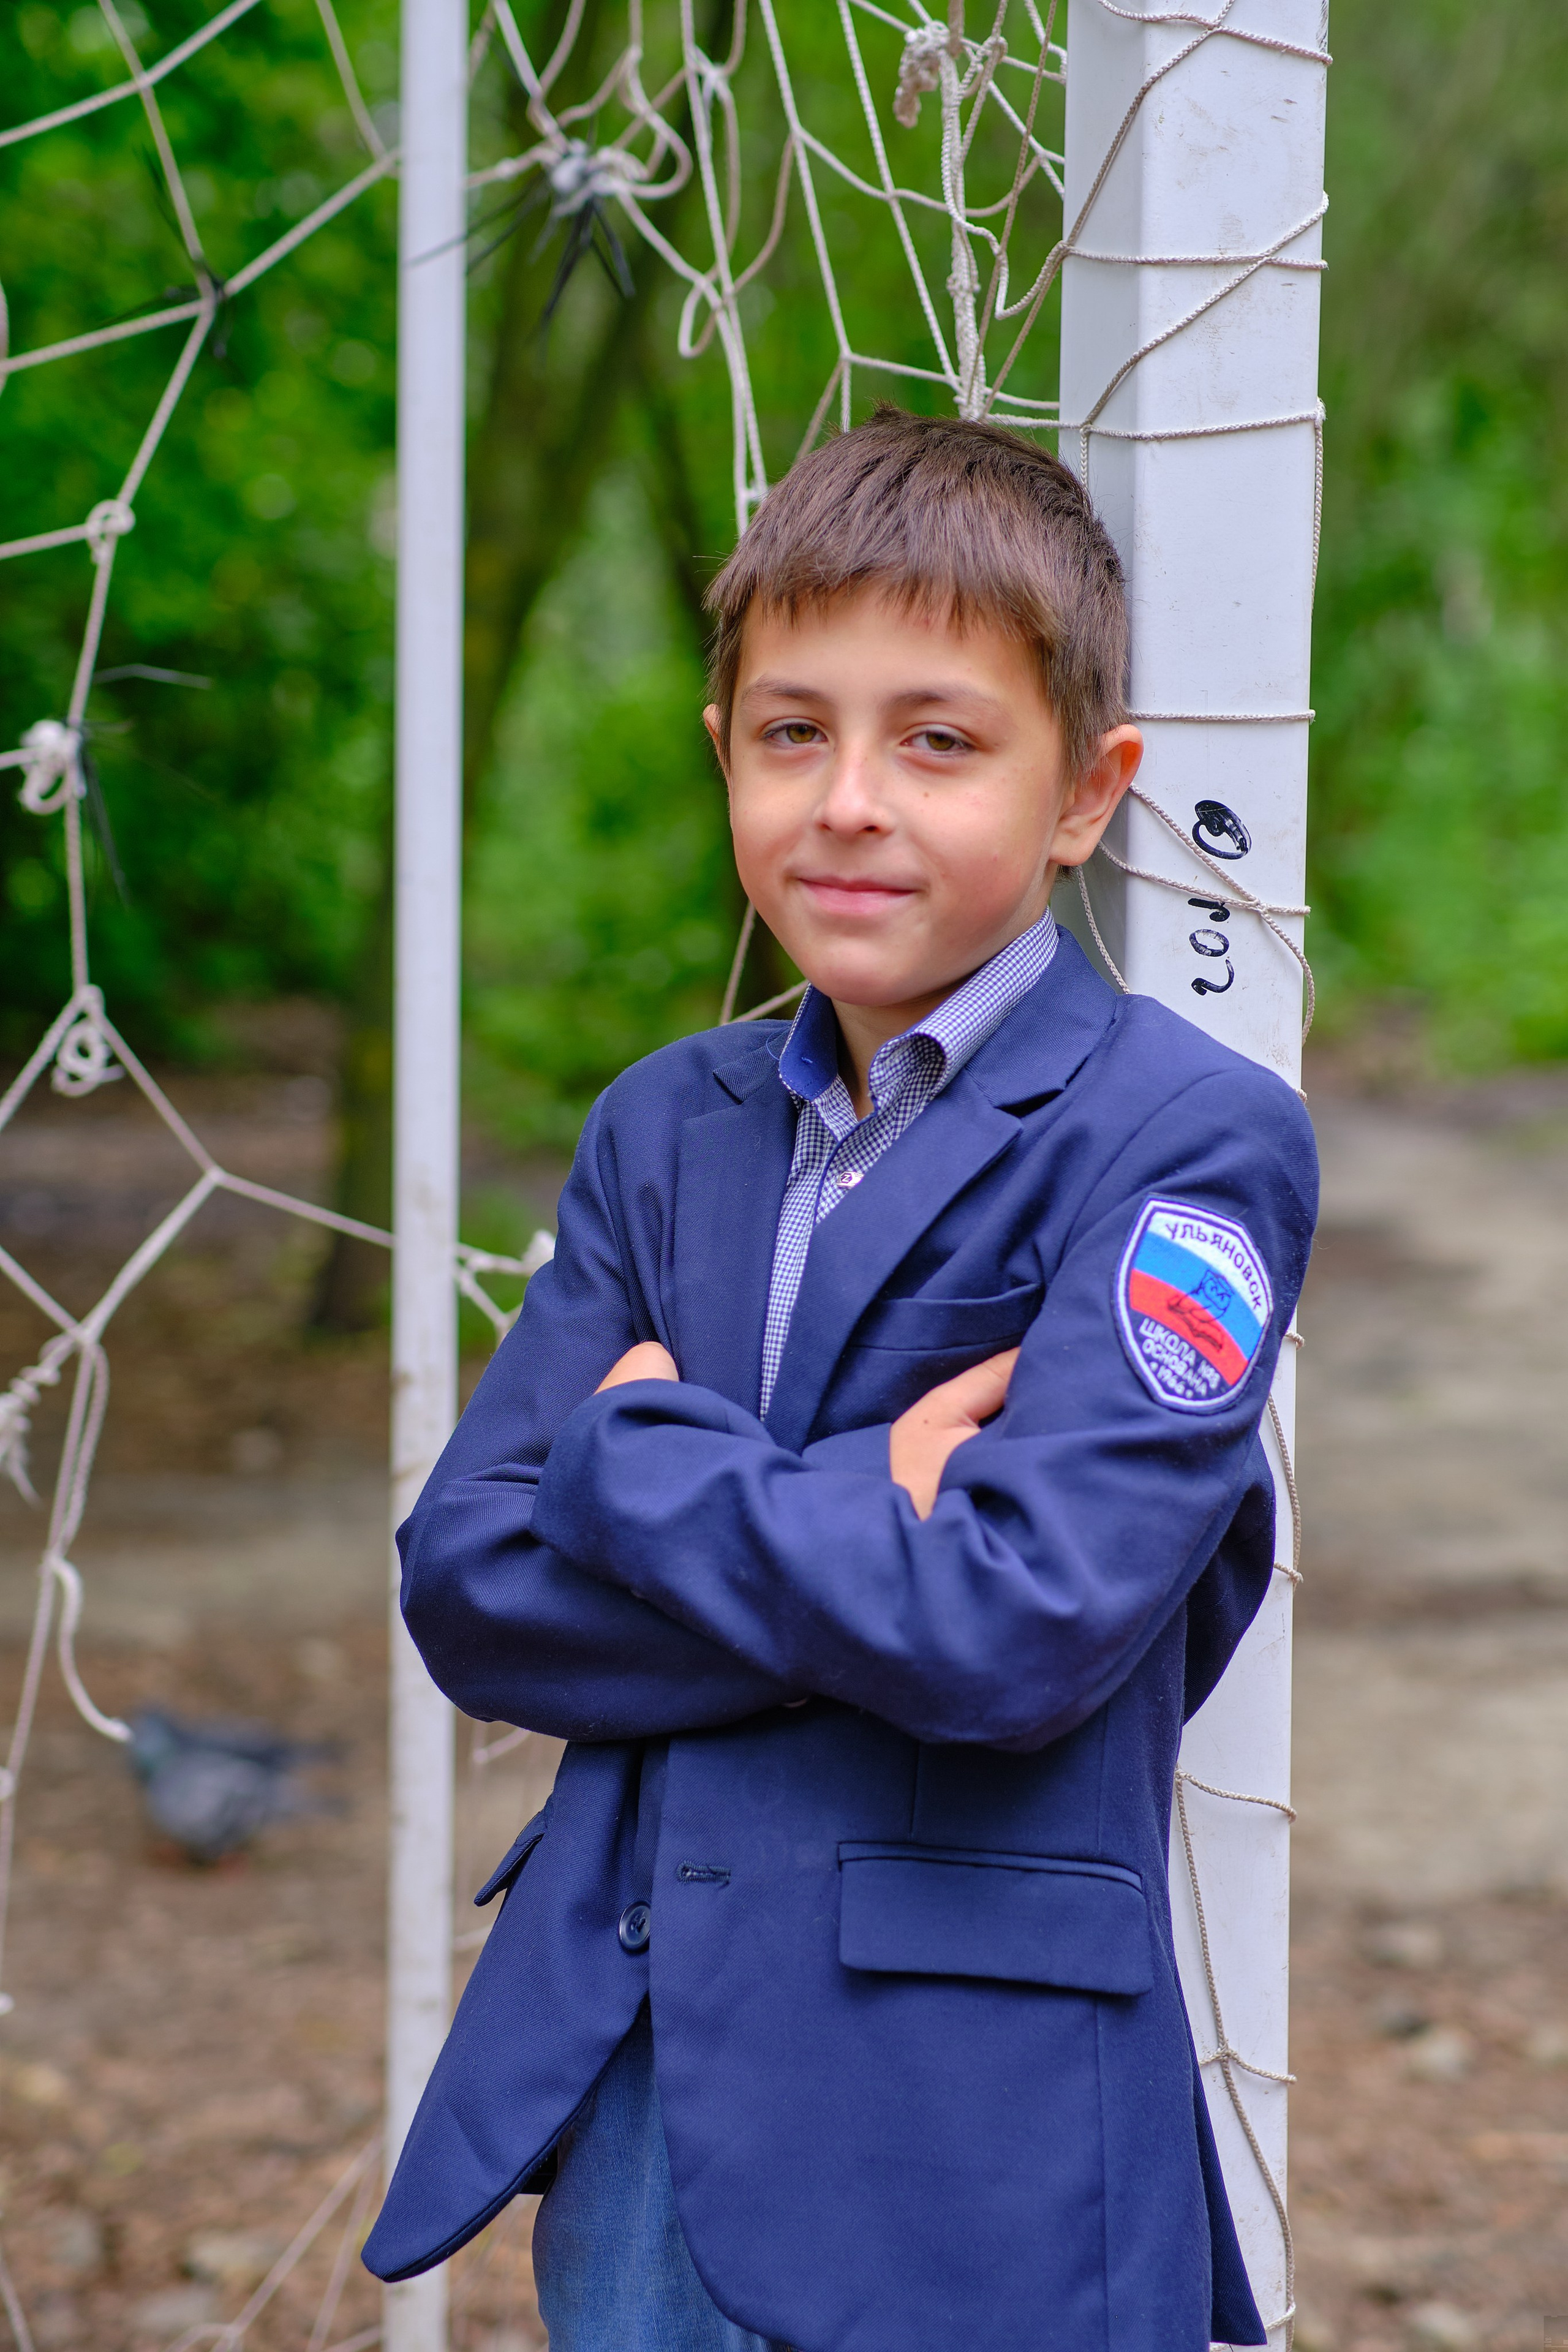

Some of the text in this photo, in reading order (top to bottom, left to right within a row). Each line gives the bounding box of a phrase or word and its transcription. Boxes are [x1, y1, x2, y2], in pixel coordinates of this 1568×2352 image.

[1165, 1223, 1261, 1310] УЛЬЯНОВСК
[1139, 1317, 1196, 1366] ШКОЛА
[1142, 1338, 1207, 1396] ОСНОВАНА
